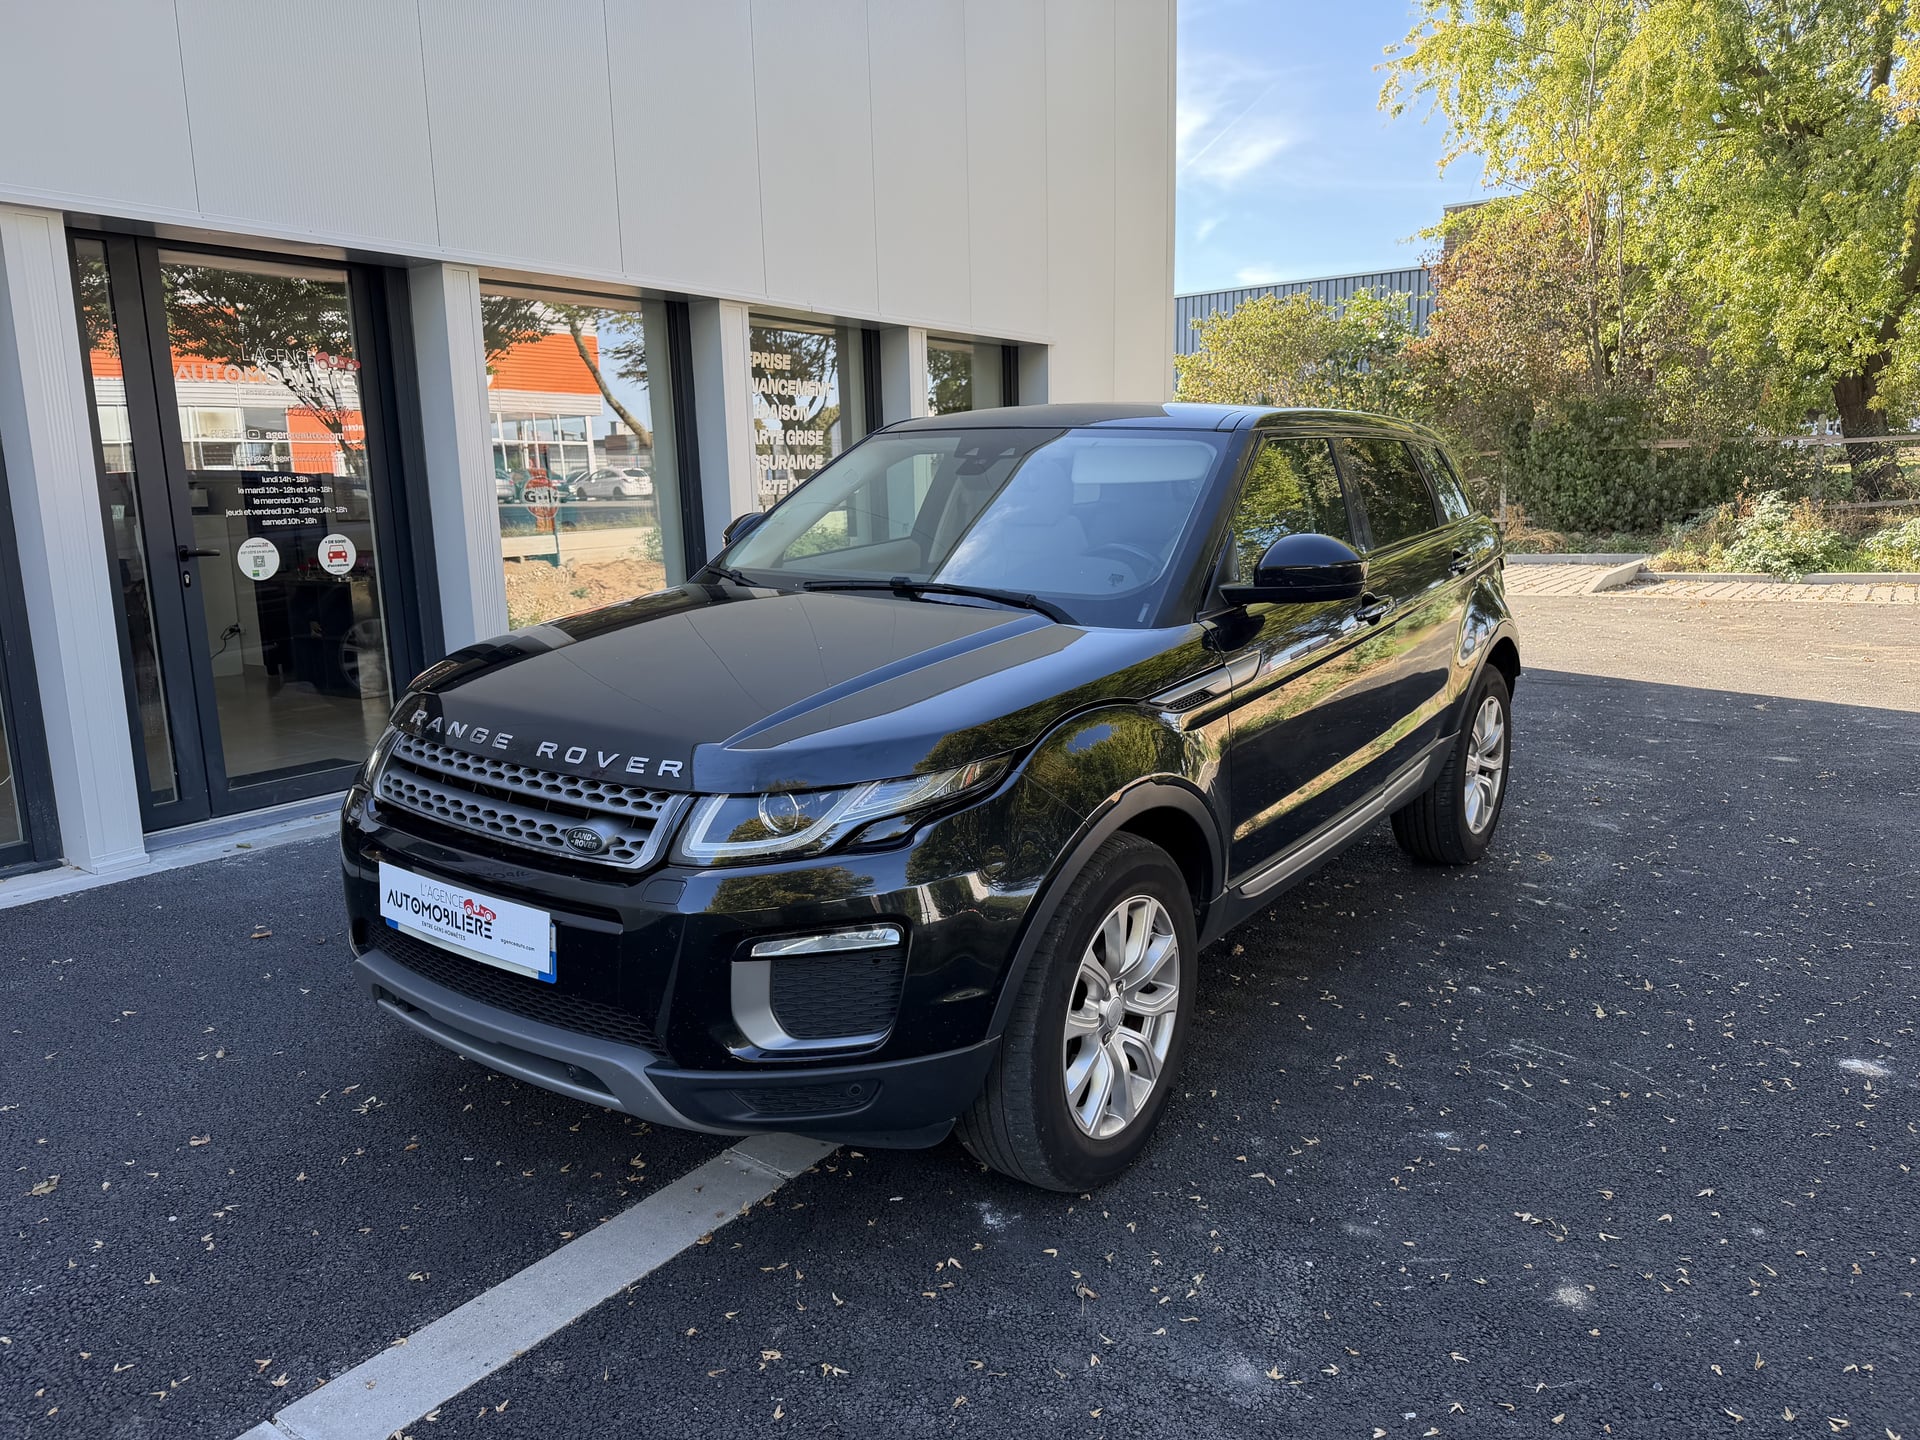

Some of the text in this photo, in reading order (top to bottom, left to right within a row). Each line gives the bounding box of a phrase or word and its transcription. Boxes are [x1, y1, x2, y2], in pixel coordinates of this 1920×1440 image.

[750, 351, 792, 370] PRISE
[786, 429, 824, 446] GRISE
[266, 486, 278, 494] 10h
[283, 486, 296, 494] 12h
[253, 497, 260, 505] le
[308, 496, 321, 504] 12h
[225, 508, 243, 518] jeudi
[243, 508, 252, 516] et
[251, 507, 281, 516] vendredi
[261, 518, 287, 526] samedi
[409, 709, 683, 778] RANGE ROVER
[573, 831, 591, 841] LAND
[574, 839, 597, 850] ROVER
[420, 882, 464, 909] L'AGENCE
